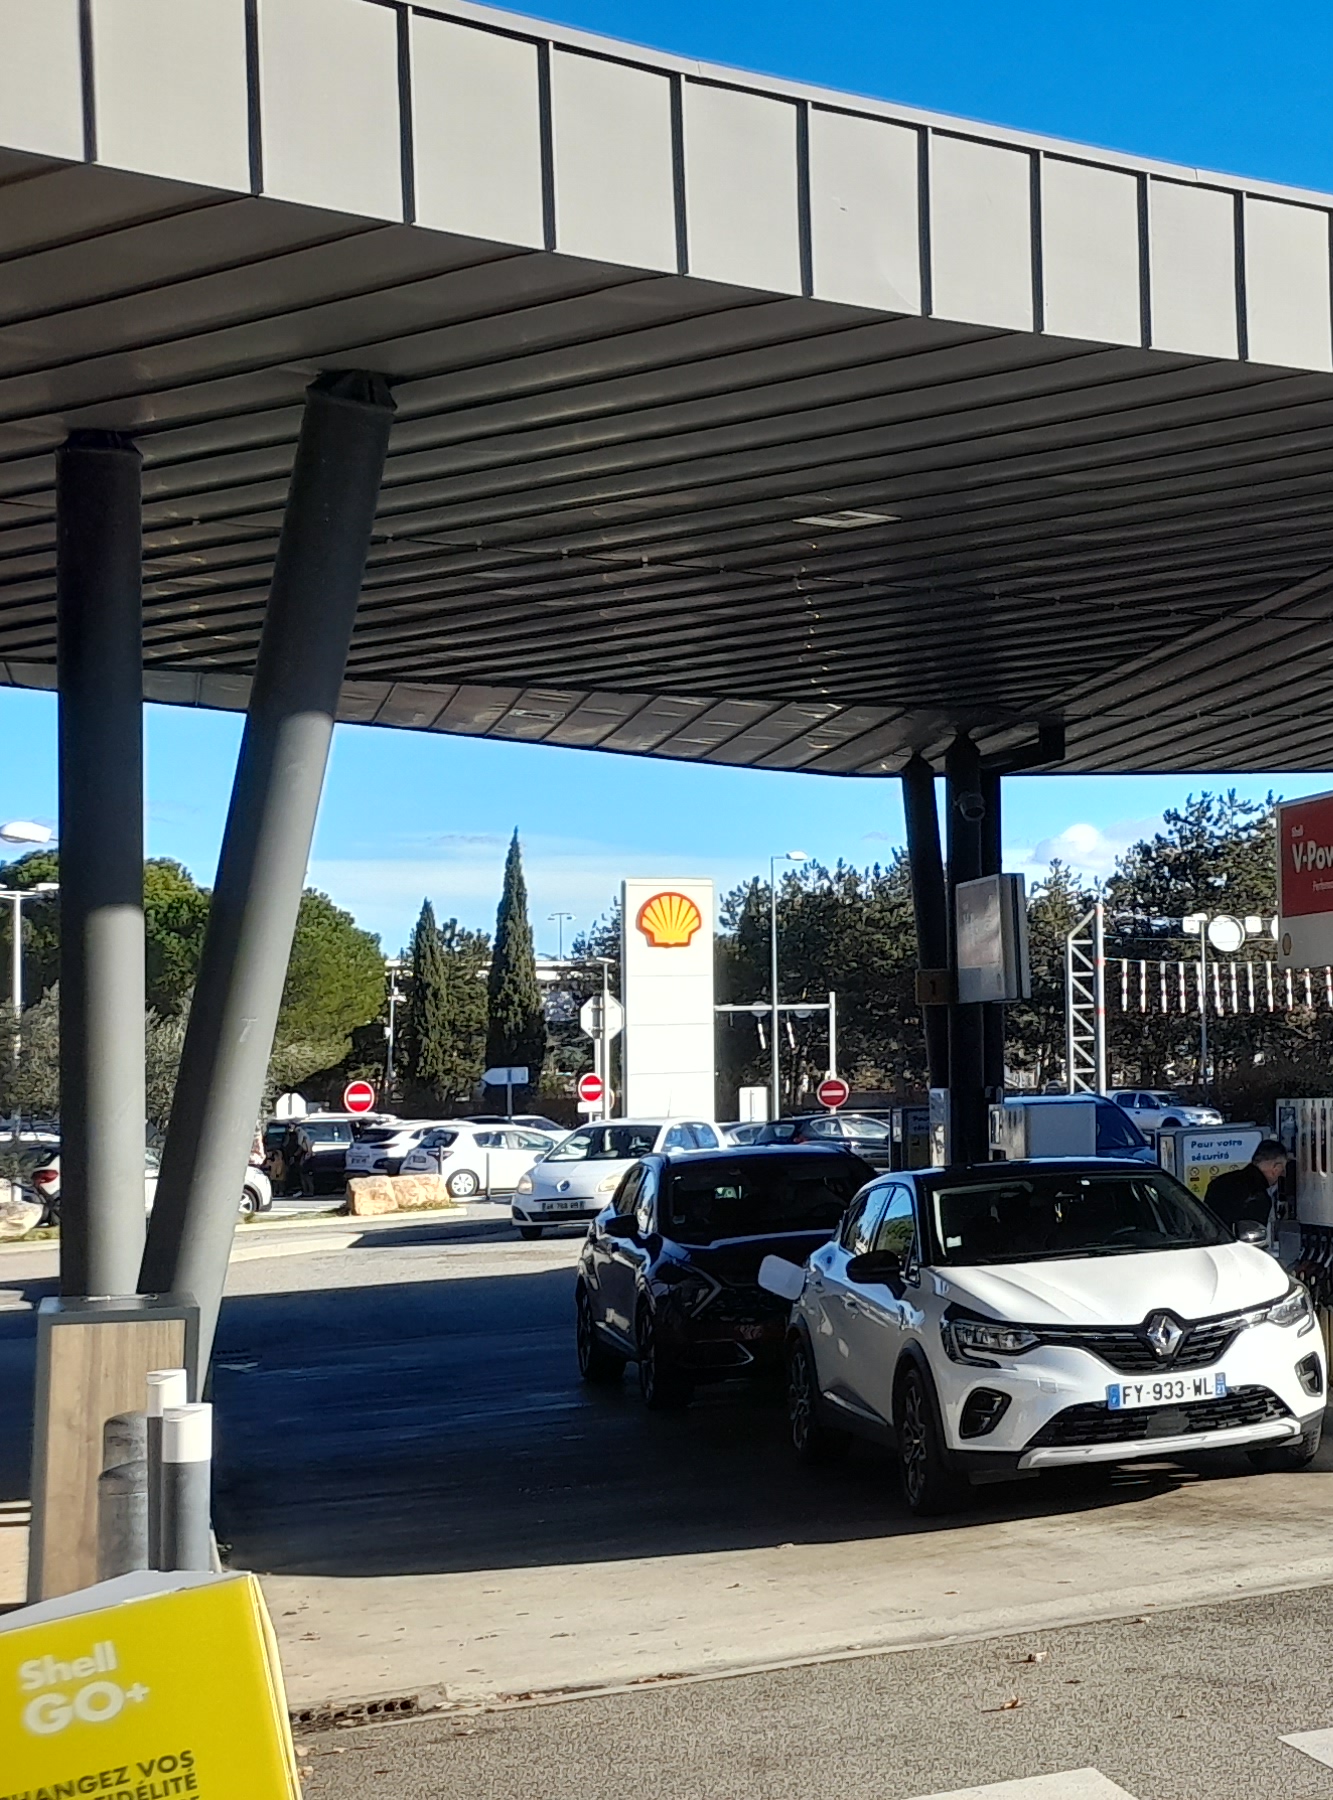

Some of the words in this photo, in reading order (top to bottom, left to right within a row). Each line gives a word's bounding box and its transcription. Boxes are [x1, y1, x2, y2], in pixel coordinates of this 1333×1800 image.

[1191, 1140, 1213, 1149] Pour
[1122, 1377, 1213, 1405] FY-933-WL
[19, 1640, 118, 1690] Shell
[0, 1765, 131, 1800] ANGEZ
[136, 1750, 194, 1778] VOS
[94, 1768, 198, 1800] DÉLITÉ
